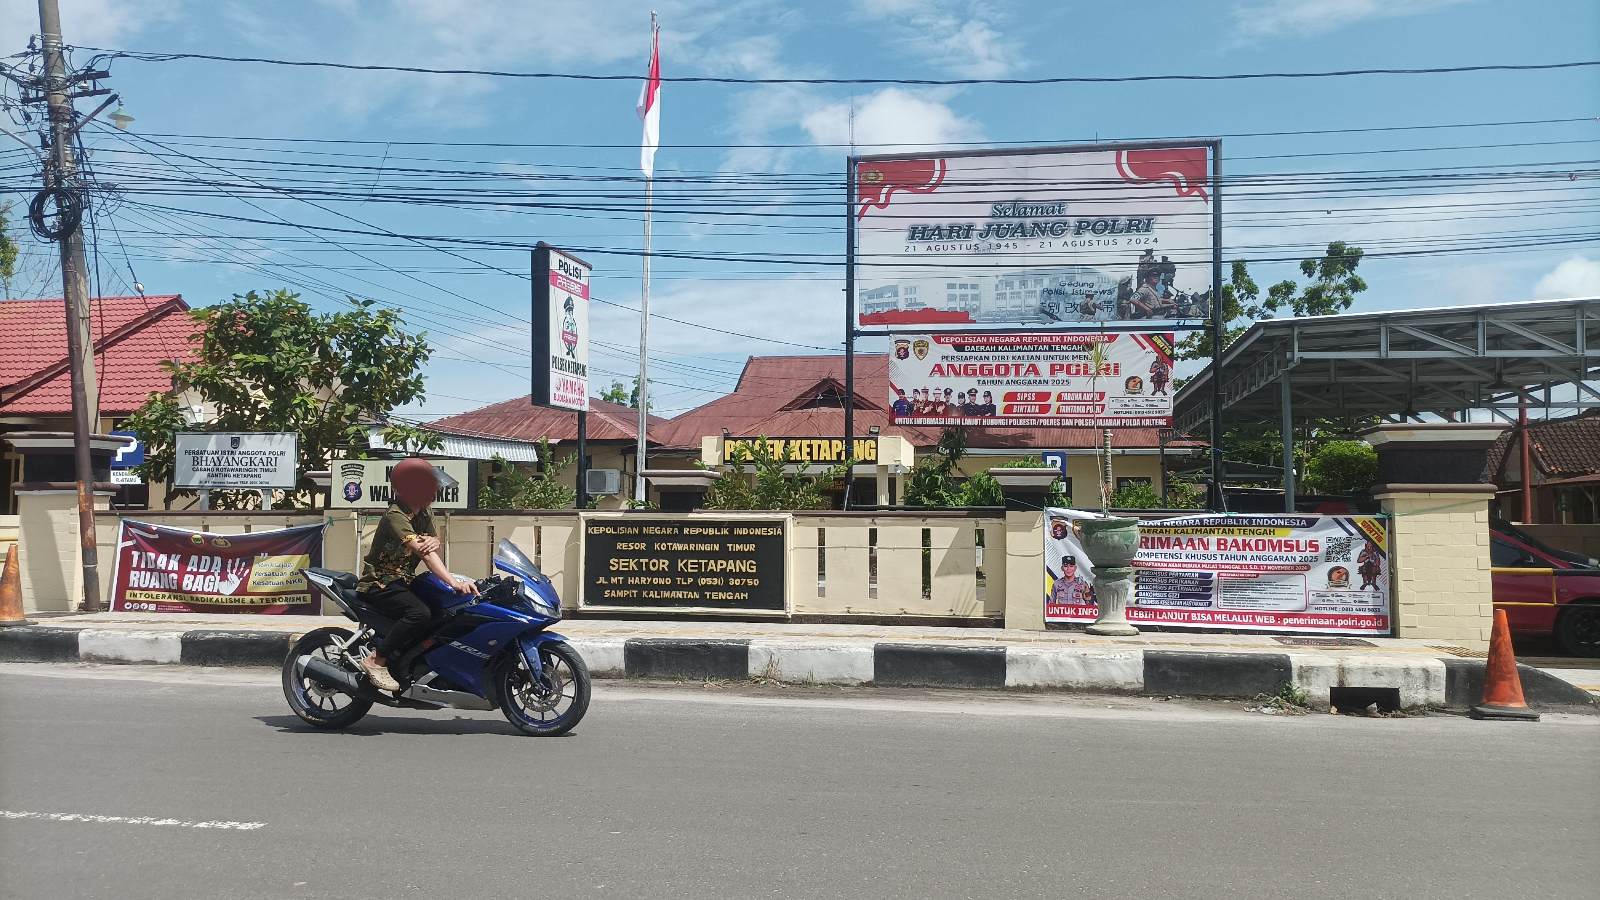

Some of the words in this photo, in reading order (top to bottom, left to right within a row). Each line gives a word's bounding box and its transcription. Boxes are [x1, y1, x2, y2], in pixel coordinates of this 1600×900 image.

[991, 201, 1066, 218] Selamat
[908, 225, 975, 241] HARI
[978, 221, 1068, 240] JUANG
[1073, 217, 1156, 236] POLRI
[926, 243, 980, 252] AGUSTUS
[988, 242, 1019, 250] 1945
[1062, 239, 1118, 248] AGUSTUS
[1127, 237, 1159, 245] 2024
[558, 258, 582, 280] POLISI
[929, 363, 1042, 378] ANGGOTA
[1016, 392, 1036, 400] SIPSS
[1012, 405, 1040, 413] BINTARA
[945, 417, 961, 425] LEBIH
[1061, 418, 1073, 426] DAN
[1121, 418, 1141, 426] POLDA
[1141, 418, 1167, 426] KALTENG
[789, 439, 877, 461] KETAPNG
[191, 456, 279, 467] BHAYANGKARI
[1163, 518, 1200, 527] NEGARA
[1203, 518, 1250, 526] REPUBLIK
[1252, 518, 1307, 526] INDONESIA
[587, 526, 639, 535] KEPOLISIAN
[642, 526, 679, 536] NEGARA
[683, 527, 730, 536] REPUBLIK
[733, 527, 783, 536] INDONESIA
[1236, 528, 1276, 536] TENGAH
[616, 542, 647, 551] RESOR
[654, 542, 720, 551] KOTAWARINGIN
[727, 543, 756, 552] TIMUR
[1216, 537, 1320, 553] BAKOMSUS
[131, 550, 181, 571] TIDAK
[187, 554, 223, 573] ADA
[1185, 552, 1218, 561] KHUSUS
[1219, 553, 1248, 561] TAHUN
[1249, 554, 1297, 563] ANGGARAN
[1298, 555, 1319, 563] 2025
[608, 557, 669, 572] SEKTOR
[677, 558, 758, 573] KETAPANG
[128, 570, 178, 590] RUANG
[182, 574, 221, 593] BAGI
[596, 577, 608, 585] JL
[610, 577, 624, 585] MT
[628, 576, 672, 585] HARYONO
[675, 577, 694, 585] TLP
[698, 577, 724, 586] (0531)
[728, 578, 760, 586] 30750
[190, 594, 246, 604] RADIKALISME
[259, 594, 308, 604] TERORISME
[603, 589, 638, 598] SAMPIT
[642, 590, 700, 599] KALIMANTAN
[704, 591, 749, 600] TENGAH
[1048, 606, 1077, 615] UNTUK
[1128, 611, 1155, 619] LEBIH
[1156, 611, 1189, 621] LANJUT
[1191, 613, 1212, 622] BISA
[1214, 614, 1253, 623] MELALUI
[1255, 615, 1275, 624] WEB
[1283, 616, 1383, 627] penerimaan.polri.go.id
